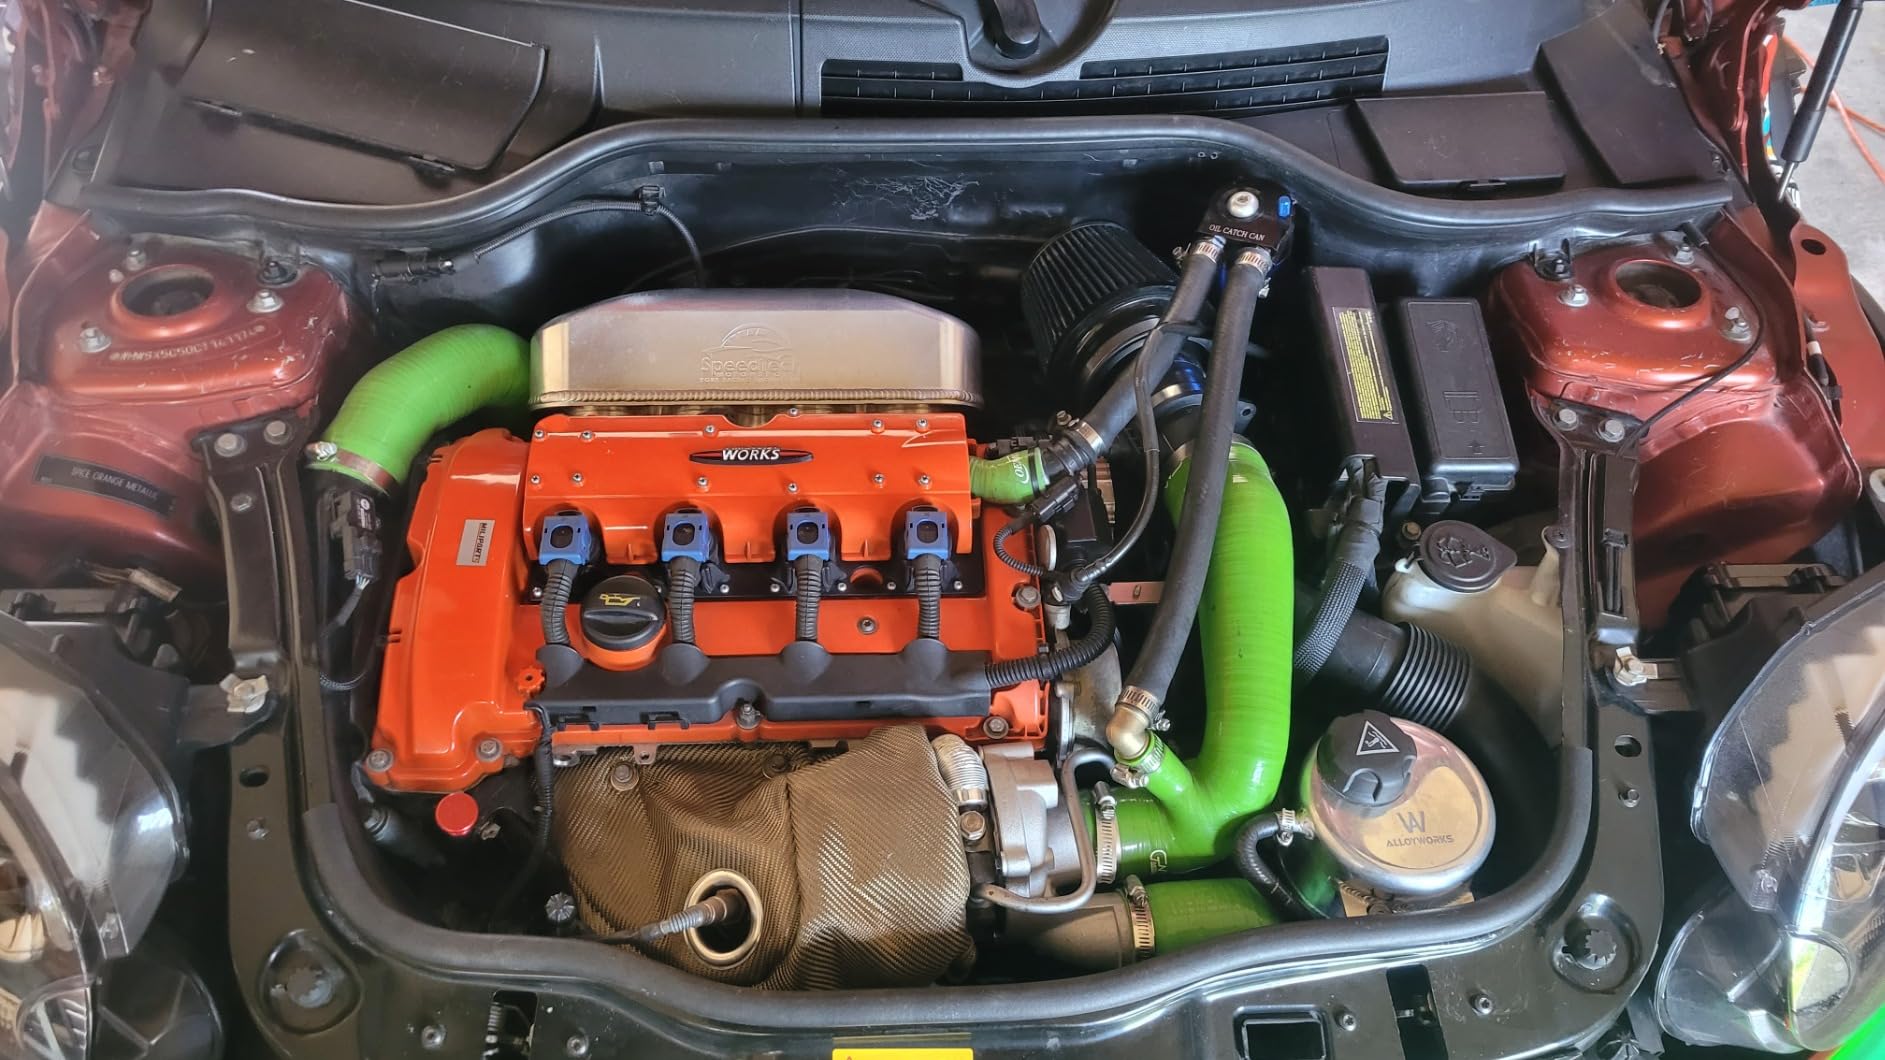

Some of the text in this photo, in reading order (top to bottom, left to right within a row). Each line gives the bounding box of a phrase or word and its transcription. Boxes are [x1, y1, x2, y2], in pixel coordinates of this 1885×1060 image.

[1209, 224, 1266, 241] OIL CATCH CAN
[722, 449, 780, 460] WORKS
[92, 471, 123, 488] ORANGE
[1386, 834, 1454, 847] ALLOYWORKS
